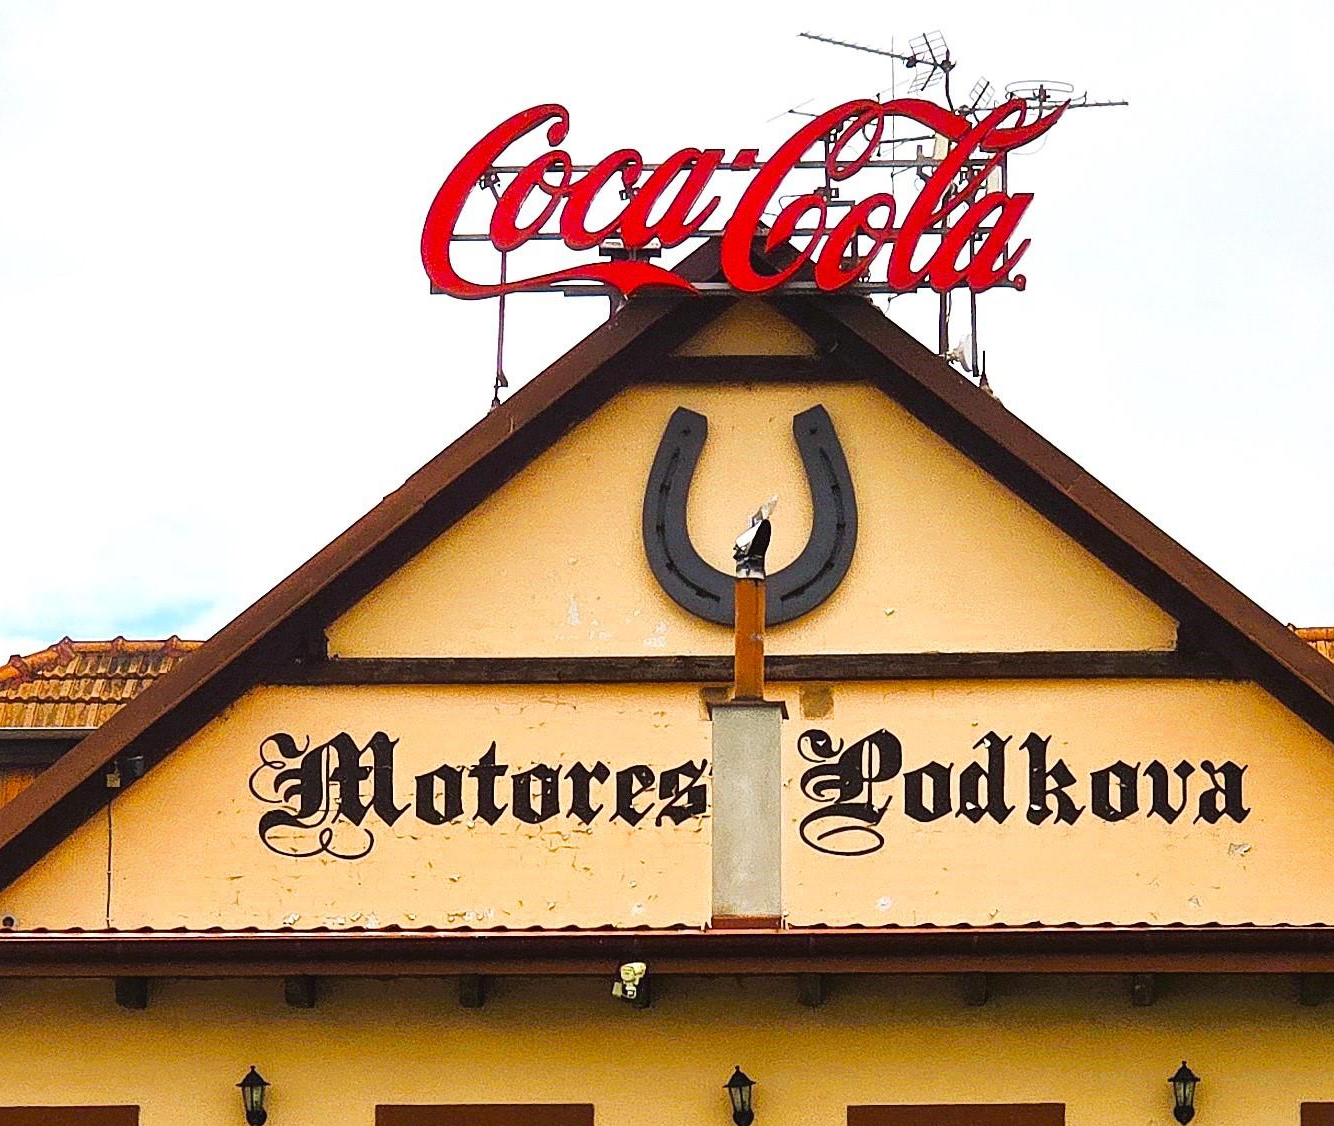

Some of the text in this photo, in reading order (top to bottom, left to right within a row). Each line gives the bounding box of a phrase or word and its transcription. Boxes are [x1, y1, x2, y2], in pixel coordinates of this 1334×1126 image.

[420, 98, 1070, 300] Coca-Cola
[249, 728, 1251, 860] Motores Podkova
